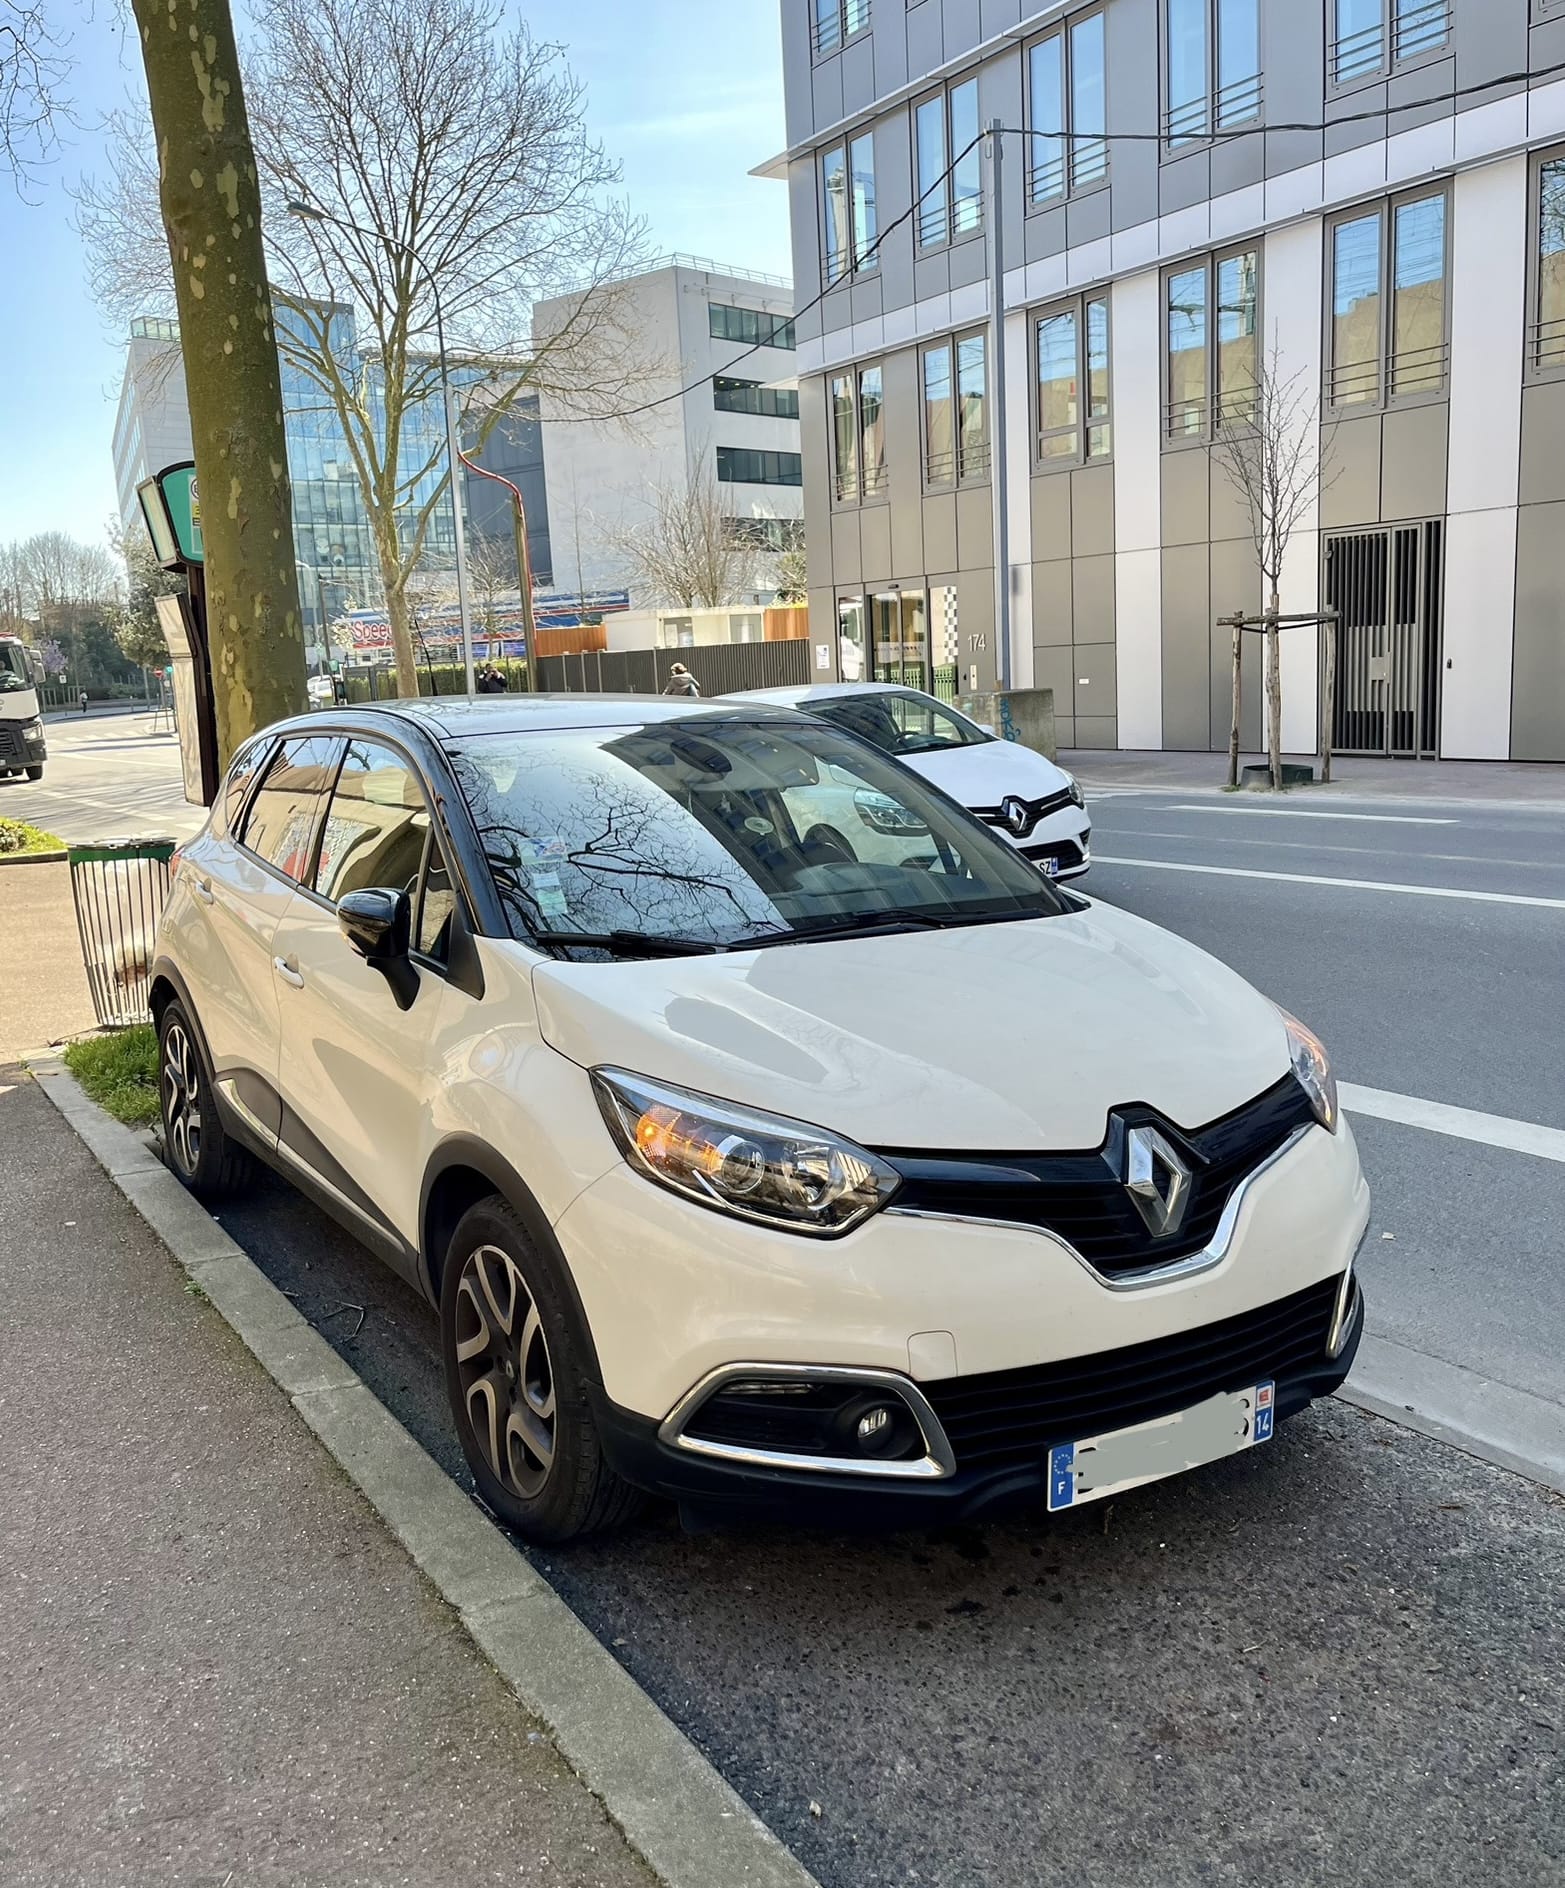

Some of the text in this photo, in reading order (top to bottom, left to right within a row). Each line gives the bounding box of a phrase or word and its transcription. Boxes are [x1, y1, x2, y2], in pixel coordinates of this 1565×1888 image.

[968, 633, 986, 652] 174
[1256, 1411, 1270, 1435] 14
[1057, 1481, 1066, 1495] F
